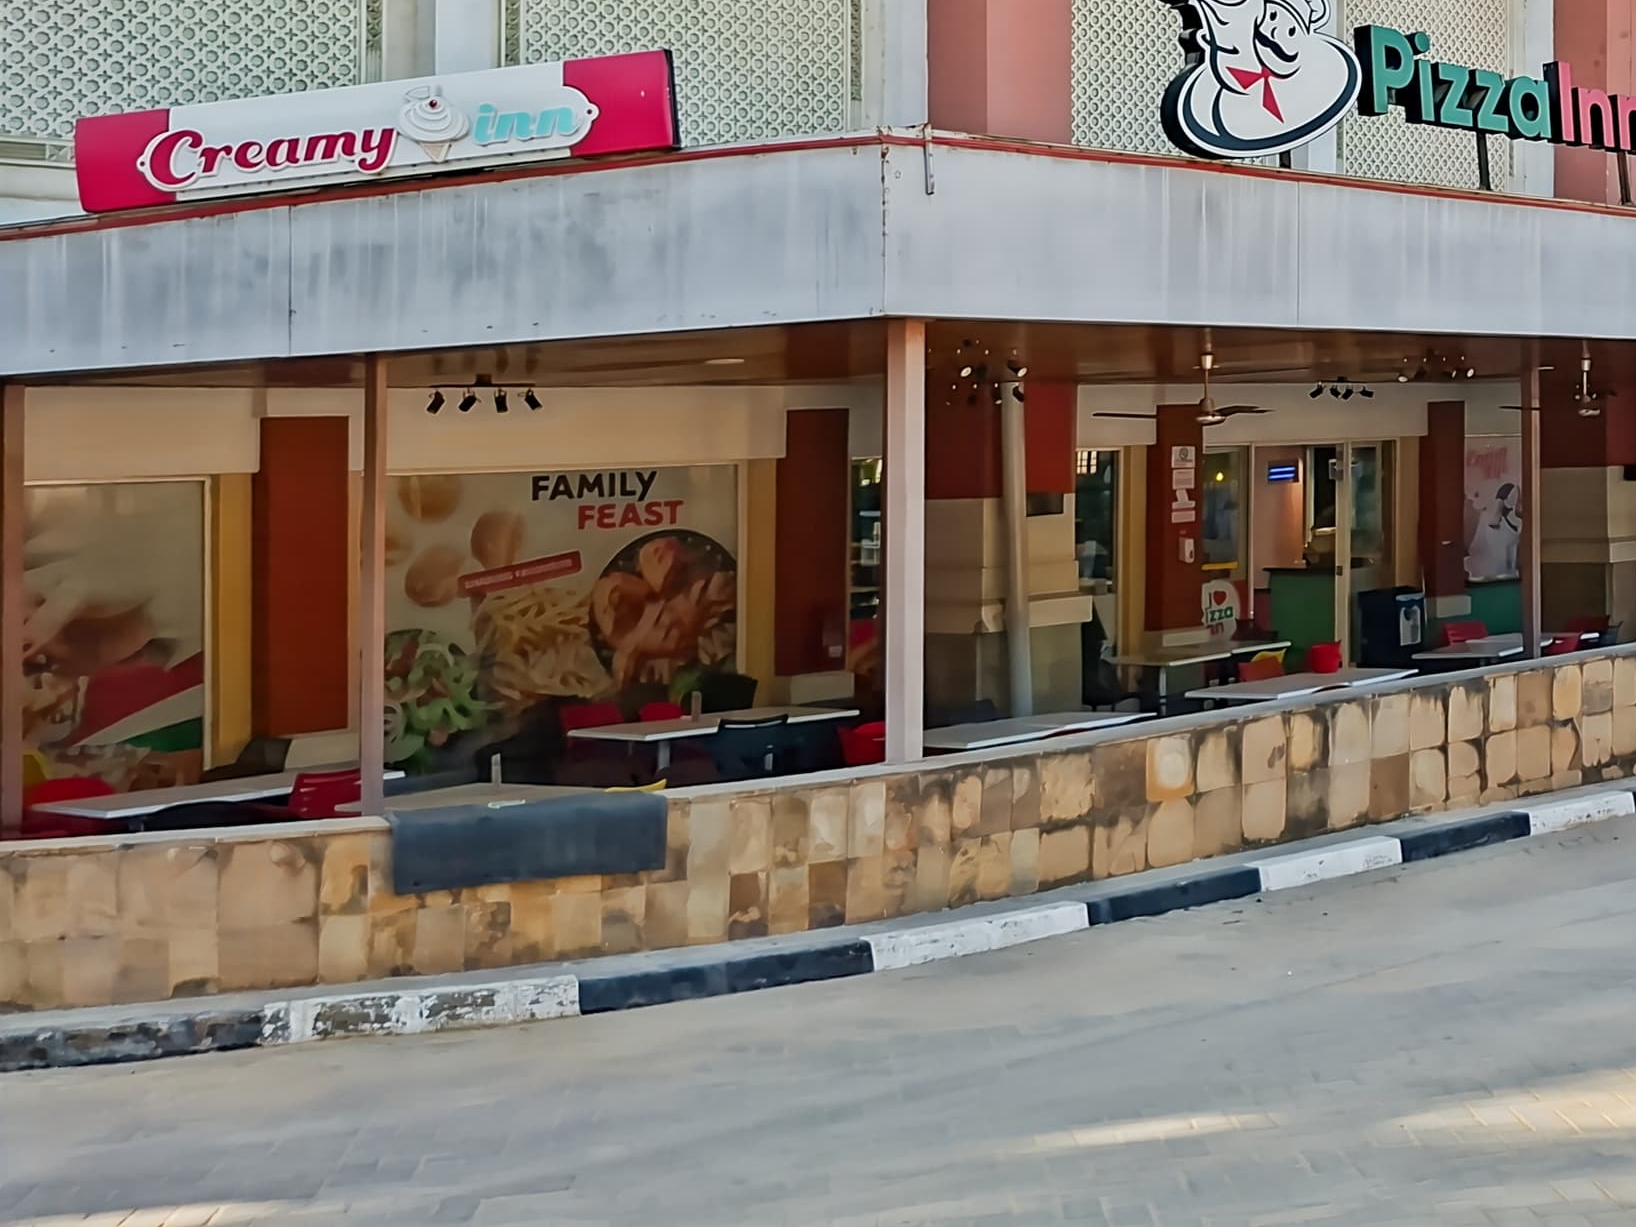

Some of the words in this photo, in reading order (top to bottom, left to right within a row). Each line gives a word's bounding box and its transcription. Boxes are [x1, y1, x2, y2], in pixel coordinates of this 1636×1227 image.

[149, 126, 396, 187] Creamy
[472, 103, 581, 143] inn
[531, 470, 658, 502] FAMILY
[577, 500, 685, 531] FEAST
